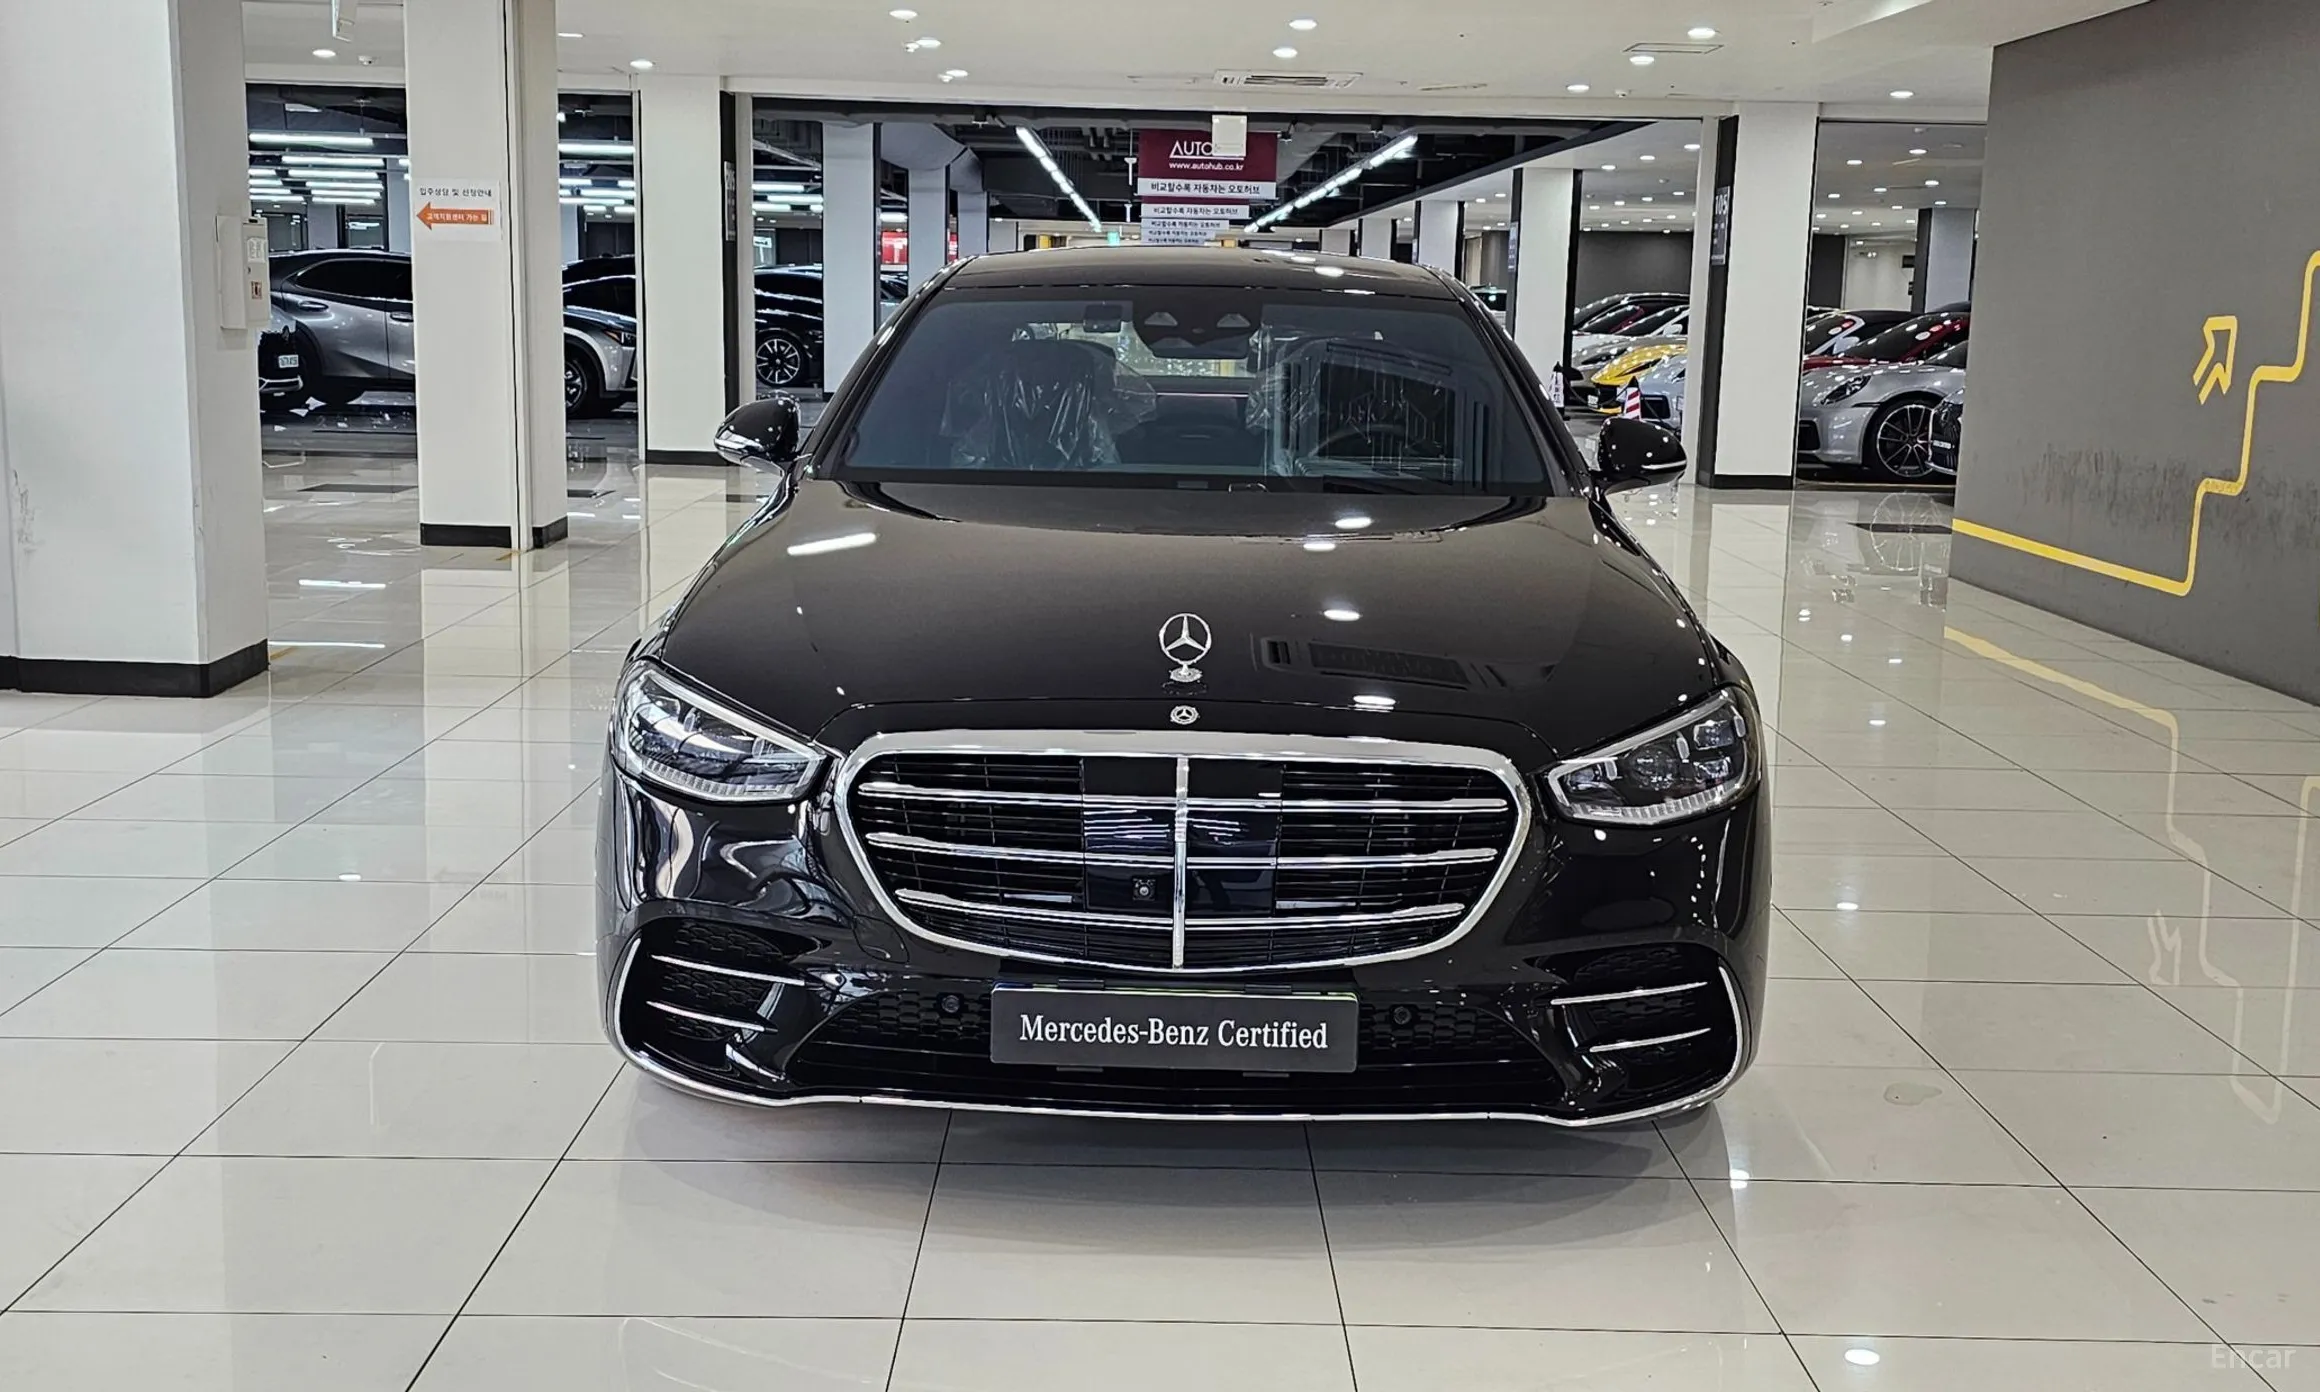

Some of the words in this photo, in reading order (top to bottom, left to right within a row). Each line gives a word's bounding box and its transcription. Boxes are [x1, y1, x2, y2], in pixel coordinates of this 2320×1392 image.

[1169, 140, 1213, 158] AUTO
[1169, 162, 1244, 171] www.autohub.co.kr
[1151, 182, 1191, 192] 비교할수록
[1193, 183, 1226, 194] 자동차는
[1227, 184, 1260, 195] 오토허브
[1153, 206, 1184, 215] 비교할수록
[1186, 207, 1211, 215] 자동차는
[1020, 1013, 1209, 1046] Mercedes-Benz
[1218, 1019, 1328, 1049] Certified
